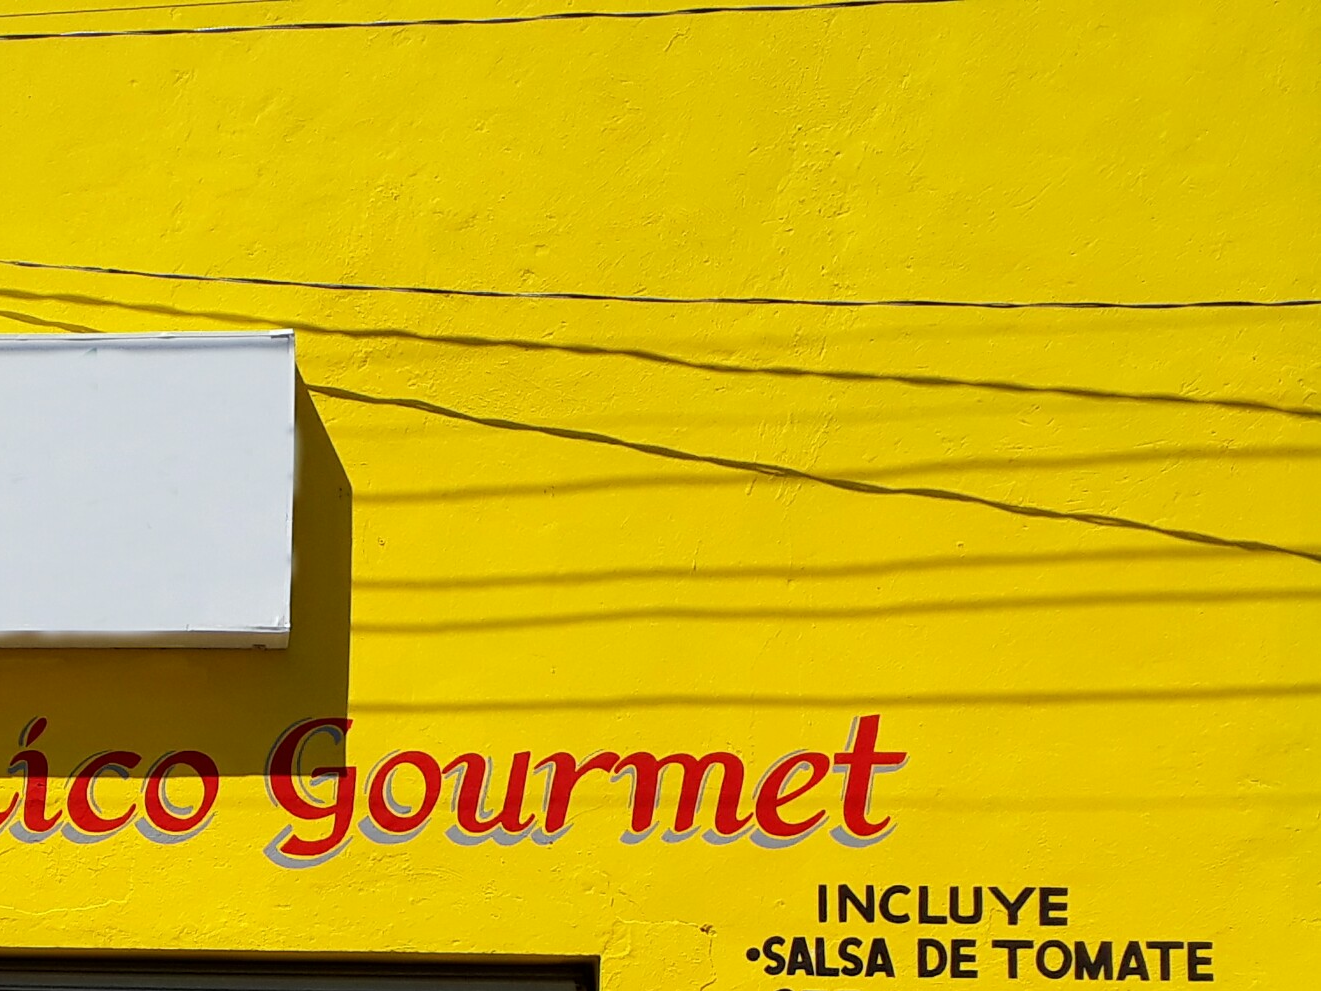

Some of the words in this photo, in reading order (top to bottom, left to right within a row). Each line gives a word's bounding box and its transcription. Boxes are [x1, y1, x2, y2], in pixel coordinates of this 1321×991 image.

[266, 713, 908, 866] Gourmet
[818, 884, 1069, 927] INCLUYE
[762, 935, 896, 978] SALSA
[917, 938, 978, 979] DE
[991, 939, 1214, 982] TOMATE
